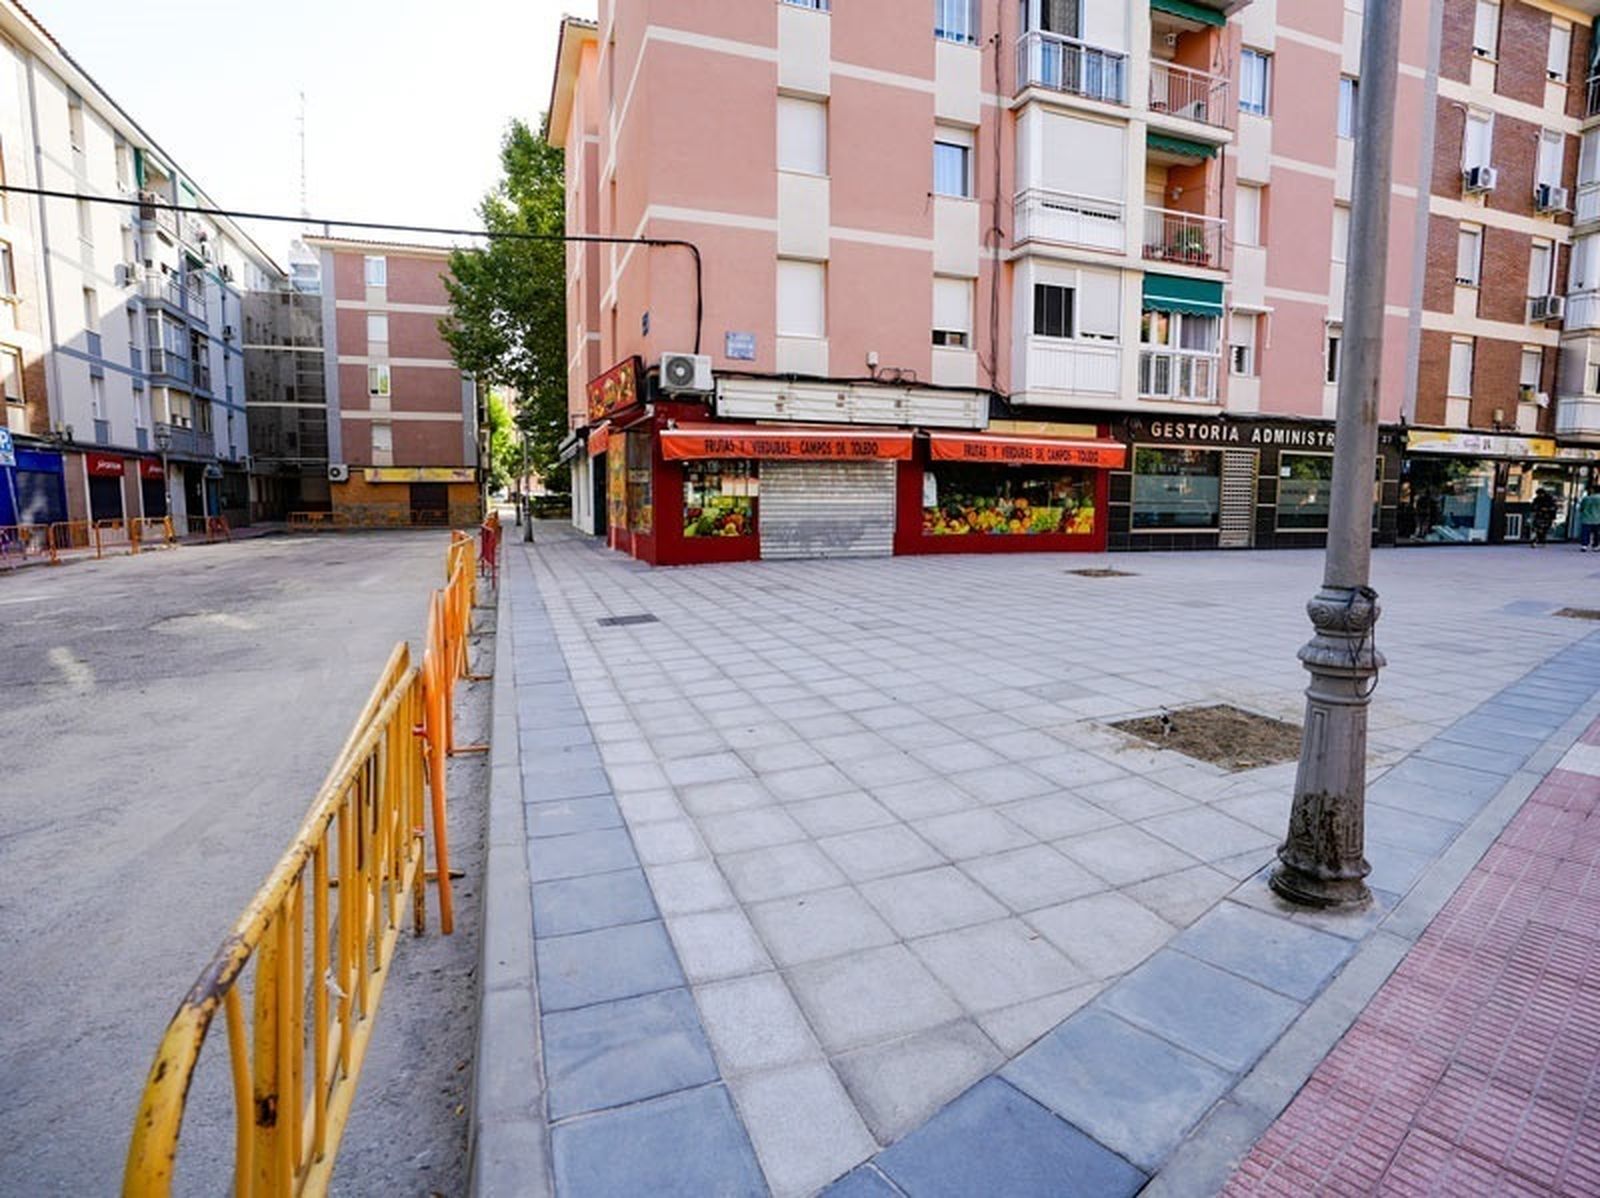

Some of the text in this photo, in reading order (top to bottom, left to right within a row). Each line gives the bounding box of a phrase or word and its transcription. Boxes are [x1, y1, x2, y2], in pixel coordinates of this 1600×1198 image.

[1151, 421, 1240, 441] GESTORIA
[1251, 427, 1336, 446] ADMINISTR
[704, 439, 734, 454] FRUTAS
[799, 440, 832, 455] CAMPOS
[836, 441, 847, 455] DE
[851, 441, 879, 455] TOLEDO
[963, 443, 1099, 463] FRUTAS Y VERDURAS DE CAMPOS TOLEDO
